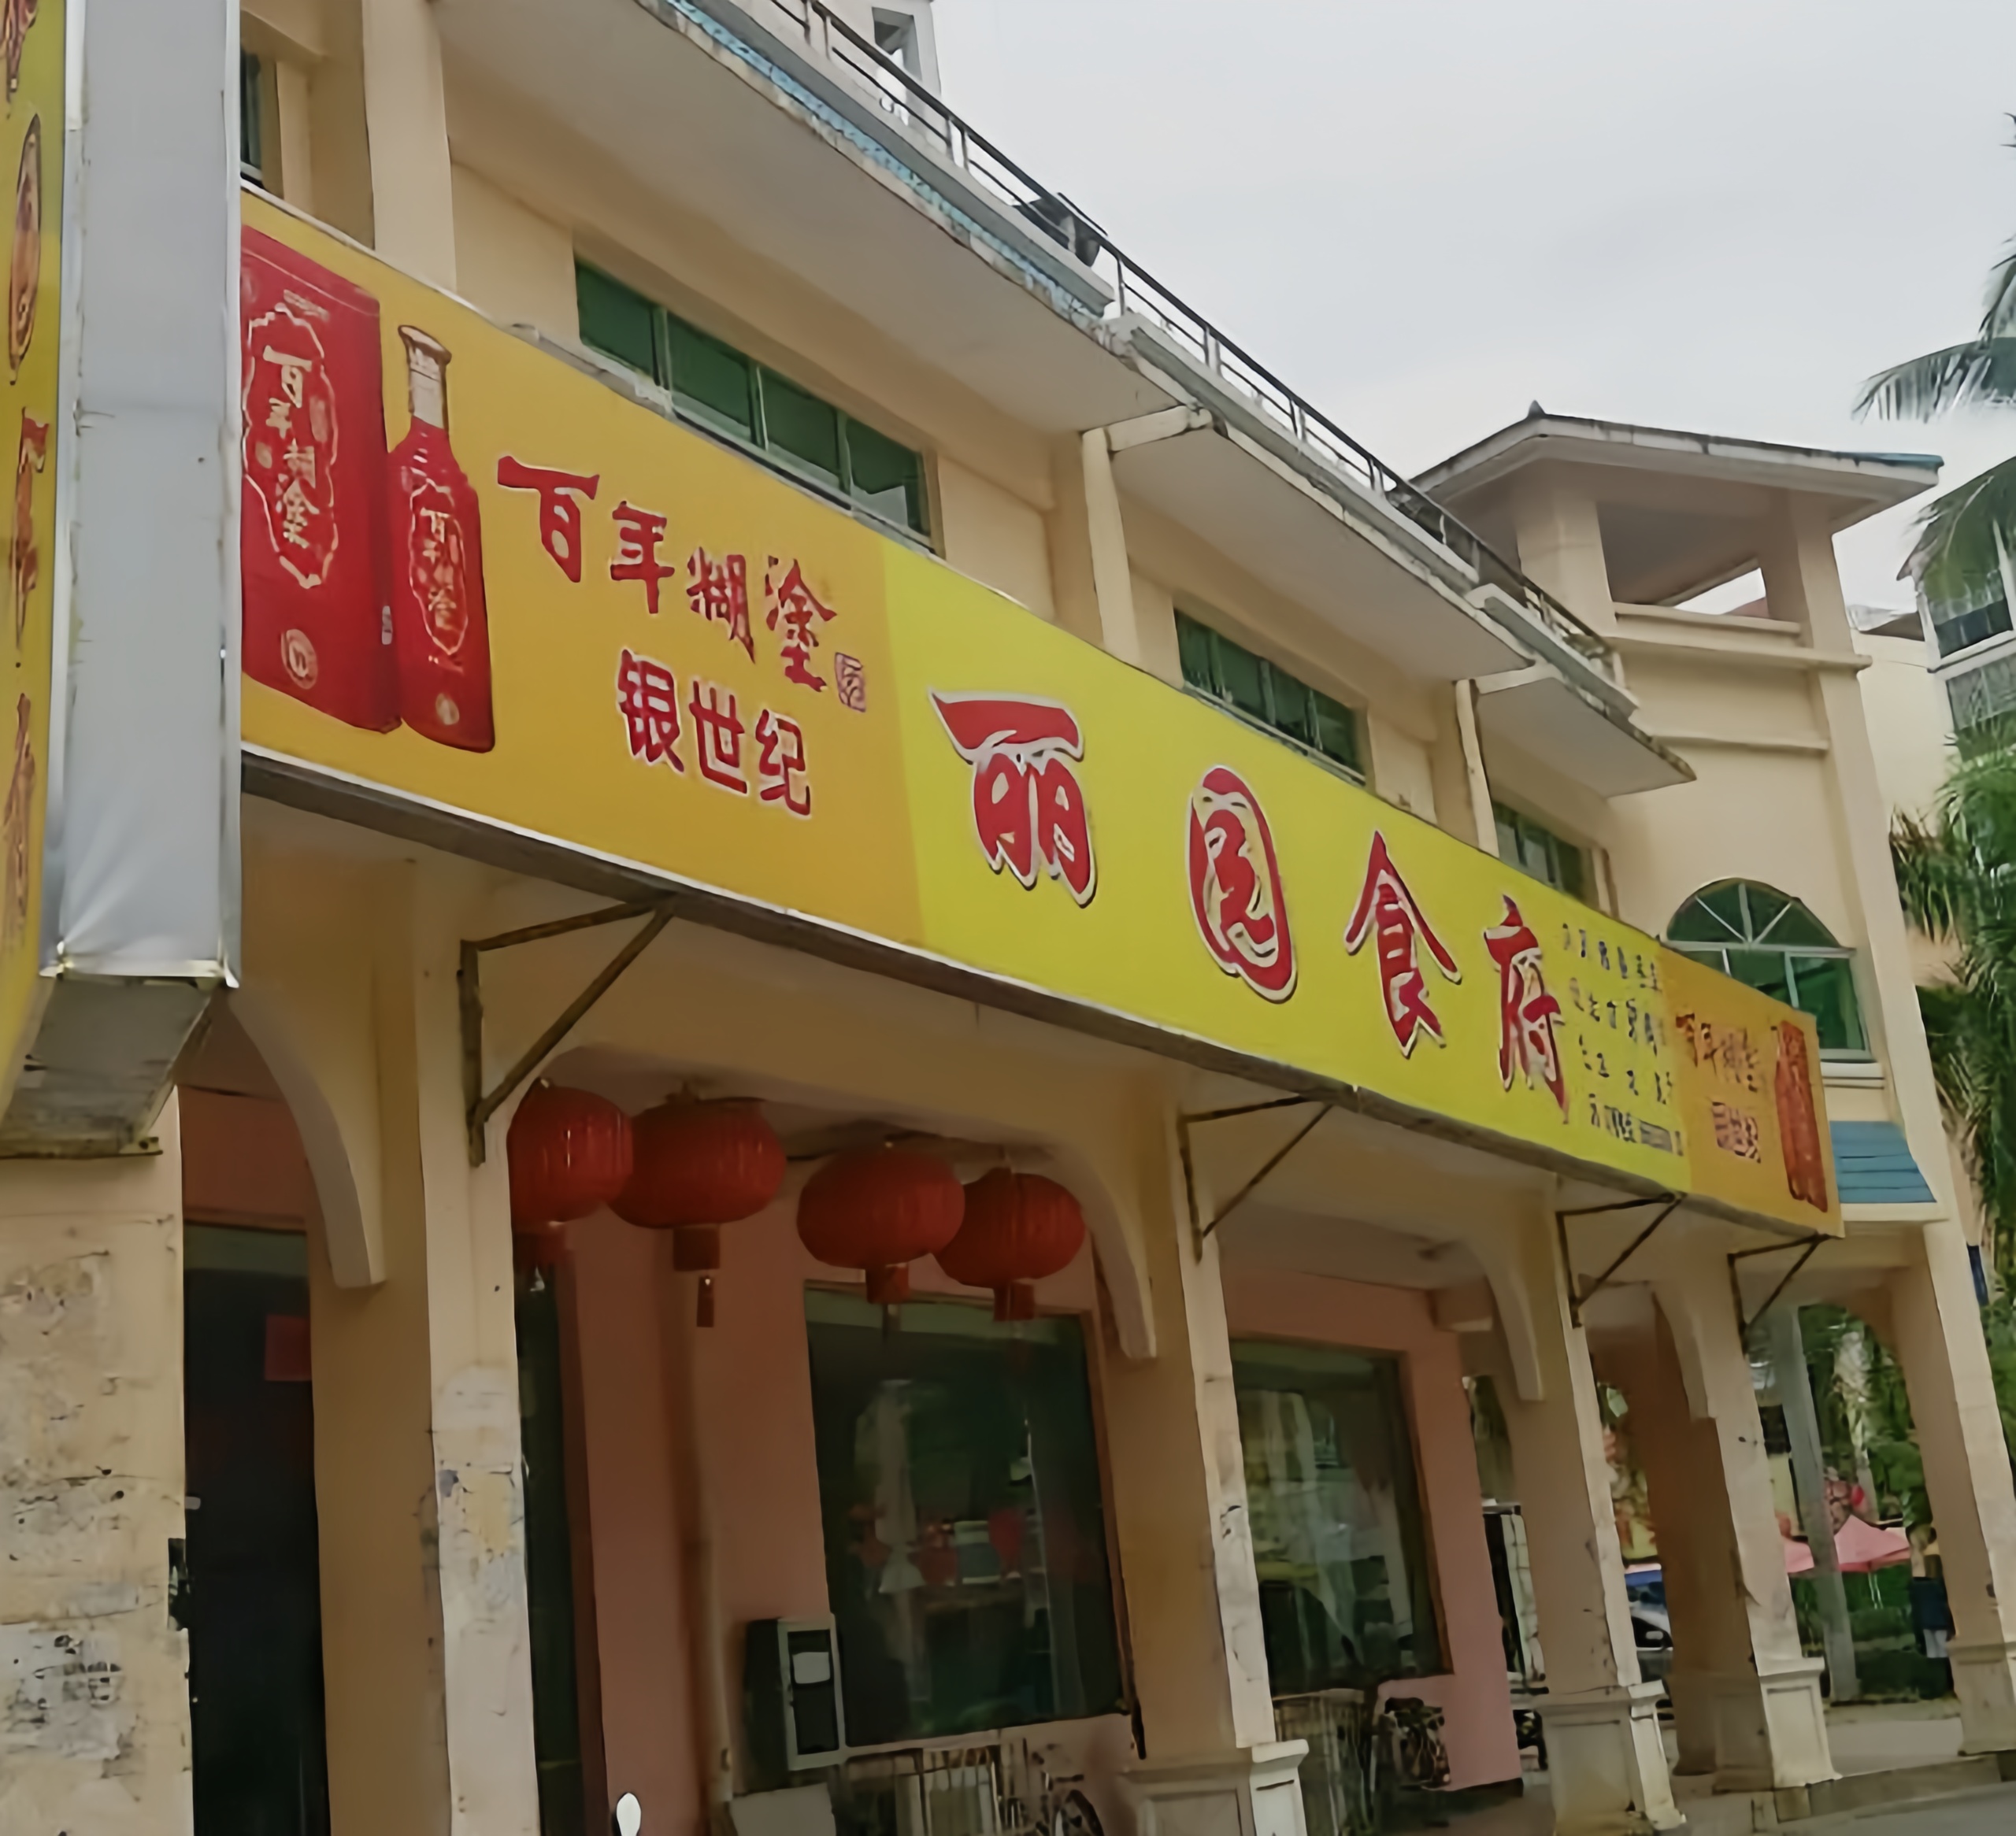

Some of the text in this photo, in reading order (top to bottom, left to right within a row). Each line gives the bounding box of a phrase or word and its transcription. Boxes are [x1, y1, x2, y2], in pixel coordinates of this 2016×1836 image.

[497, 456, 837, 693] 百年糊涂
[617, 649, 811, 817] 银世纪
